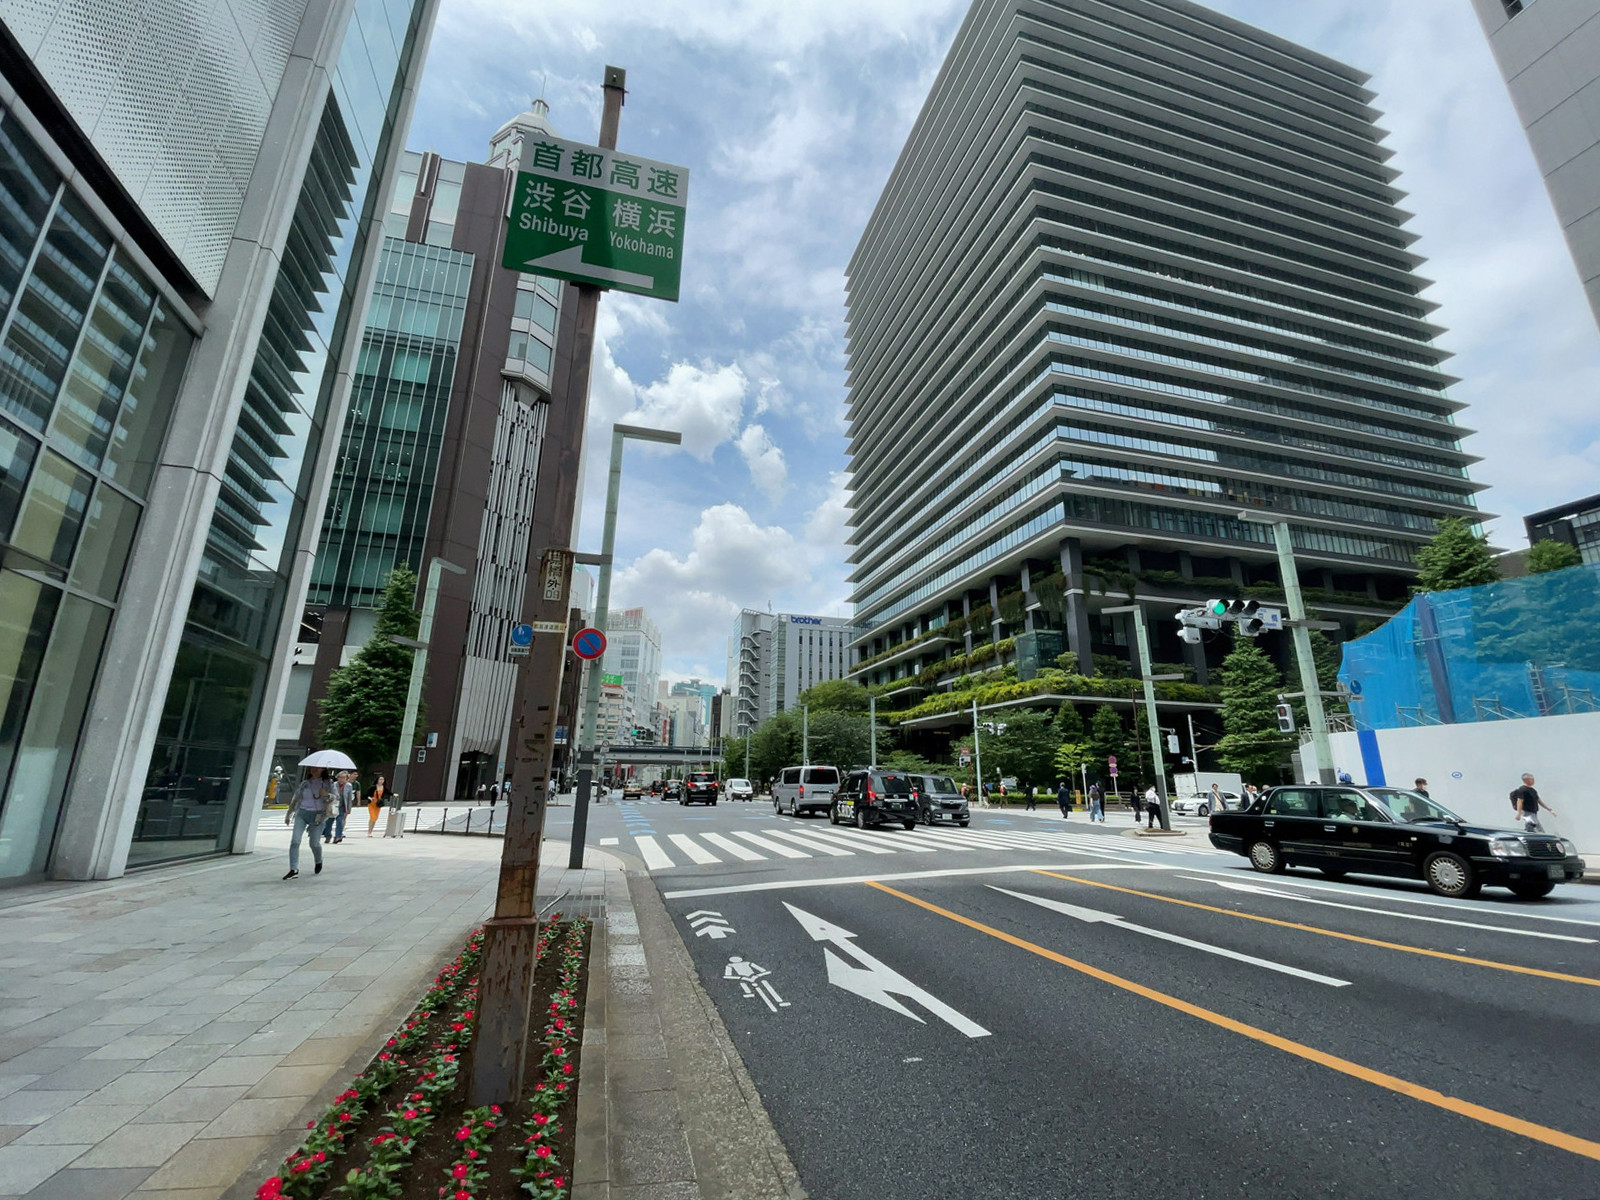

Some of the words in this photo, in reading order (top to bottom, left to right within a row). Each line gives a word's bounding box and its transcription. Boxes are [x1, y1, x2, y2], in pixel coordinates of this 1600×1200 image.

[533, 141, 678, 199] 首都高速
[519, 212, 589, 242] Shibuya
[609, 231, 674, 259] Yokohama
[522, 180, 591, 220] 渋谷
[612, 198, 676, 239] 横浜
[790, 615, 822, 625] brother
